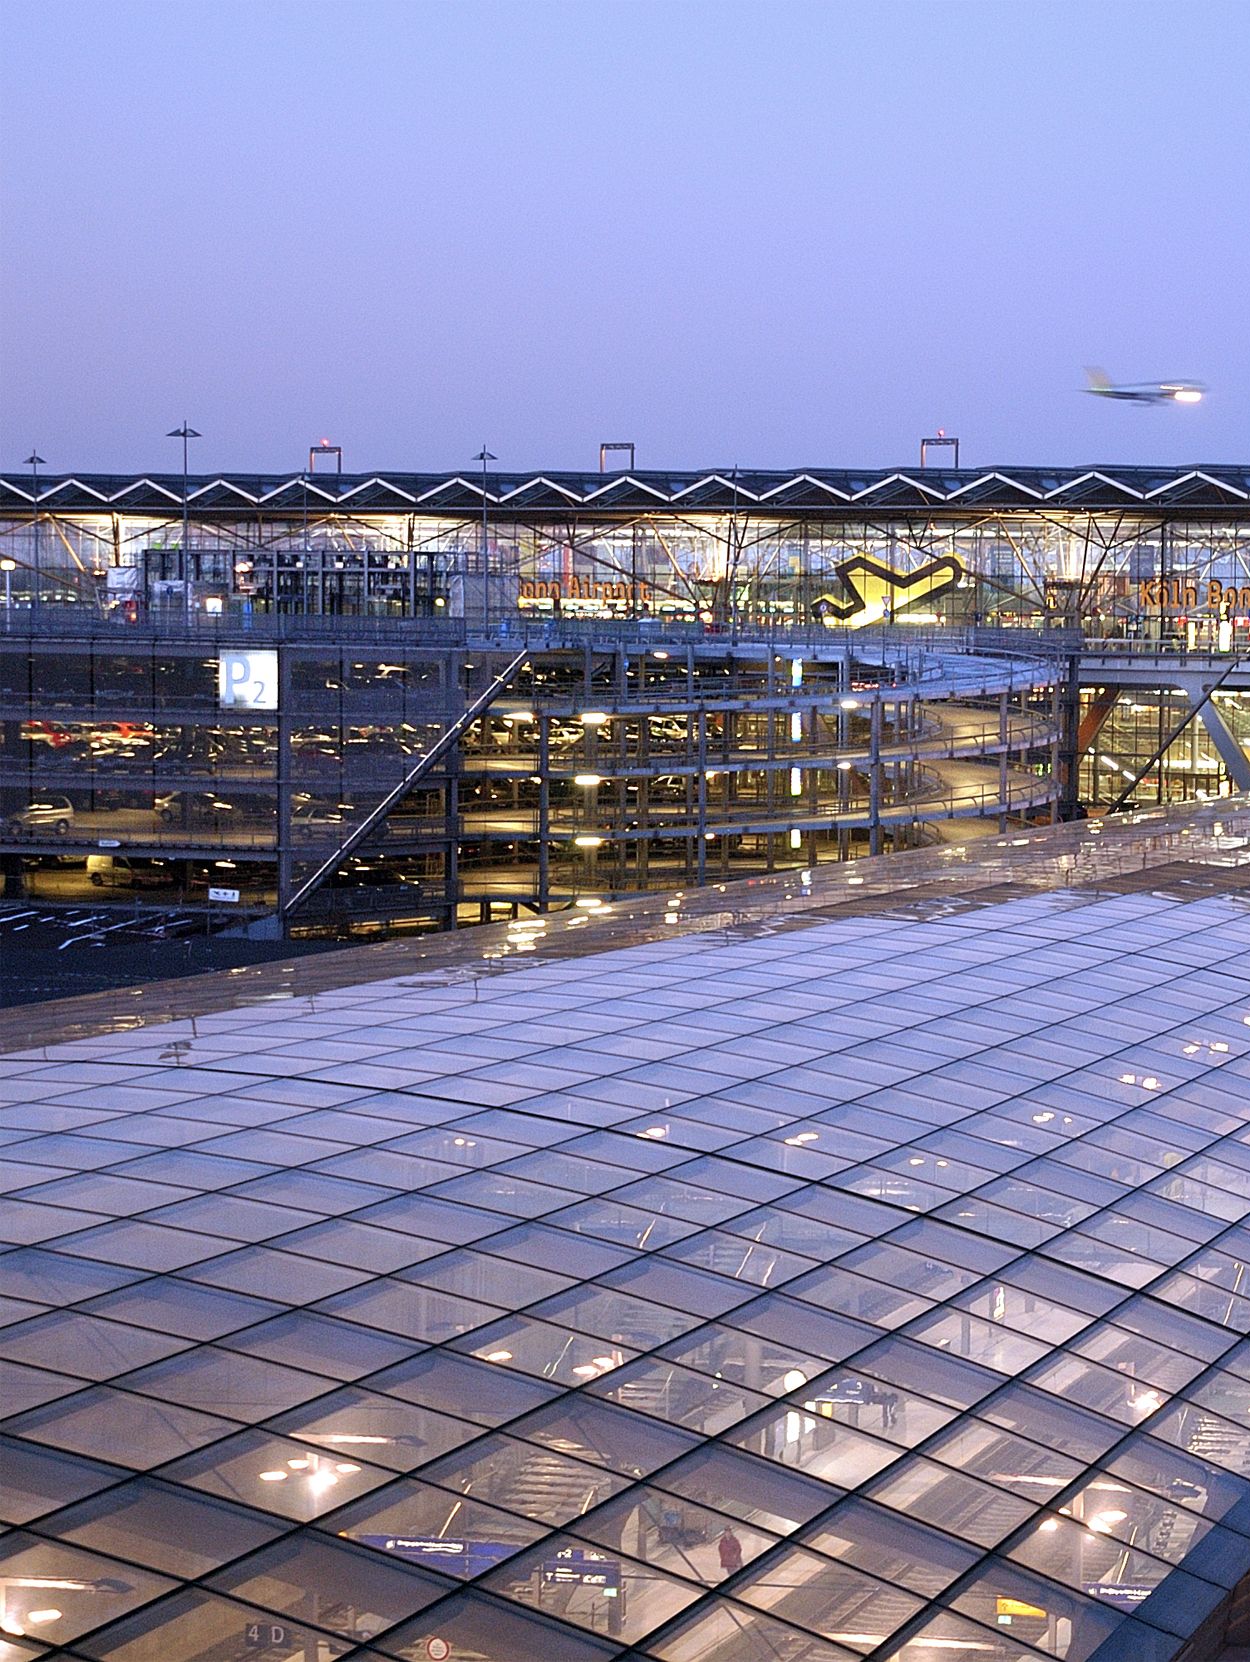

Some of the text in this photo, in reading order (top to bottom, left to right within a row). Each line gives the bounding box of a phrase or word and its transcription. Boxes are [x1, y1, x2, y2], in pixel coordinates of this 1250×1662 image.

[568, 575, 652, 607] Airport
[1139, 579, 1197, 608] Köln
[248, 1624, 285, 1644] 4 D
